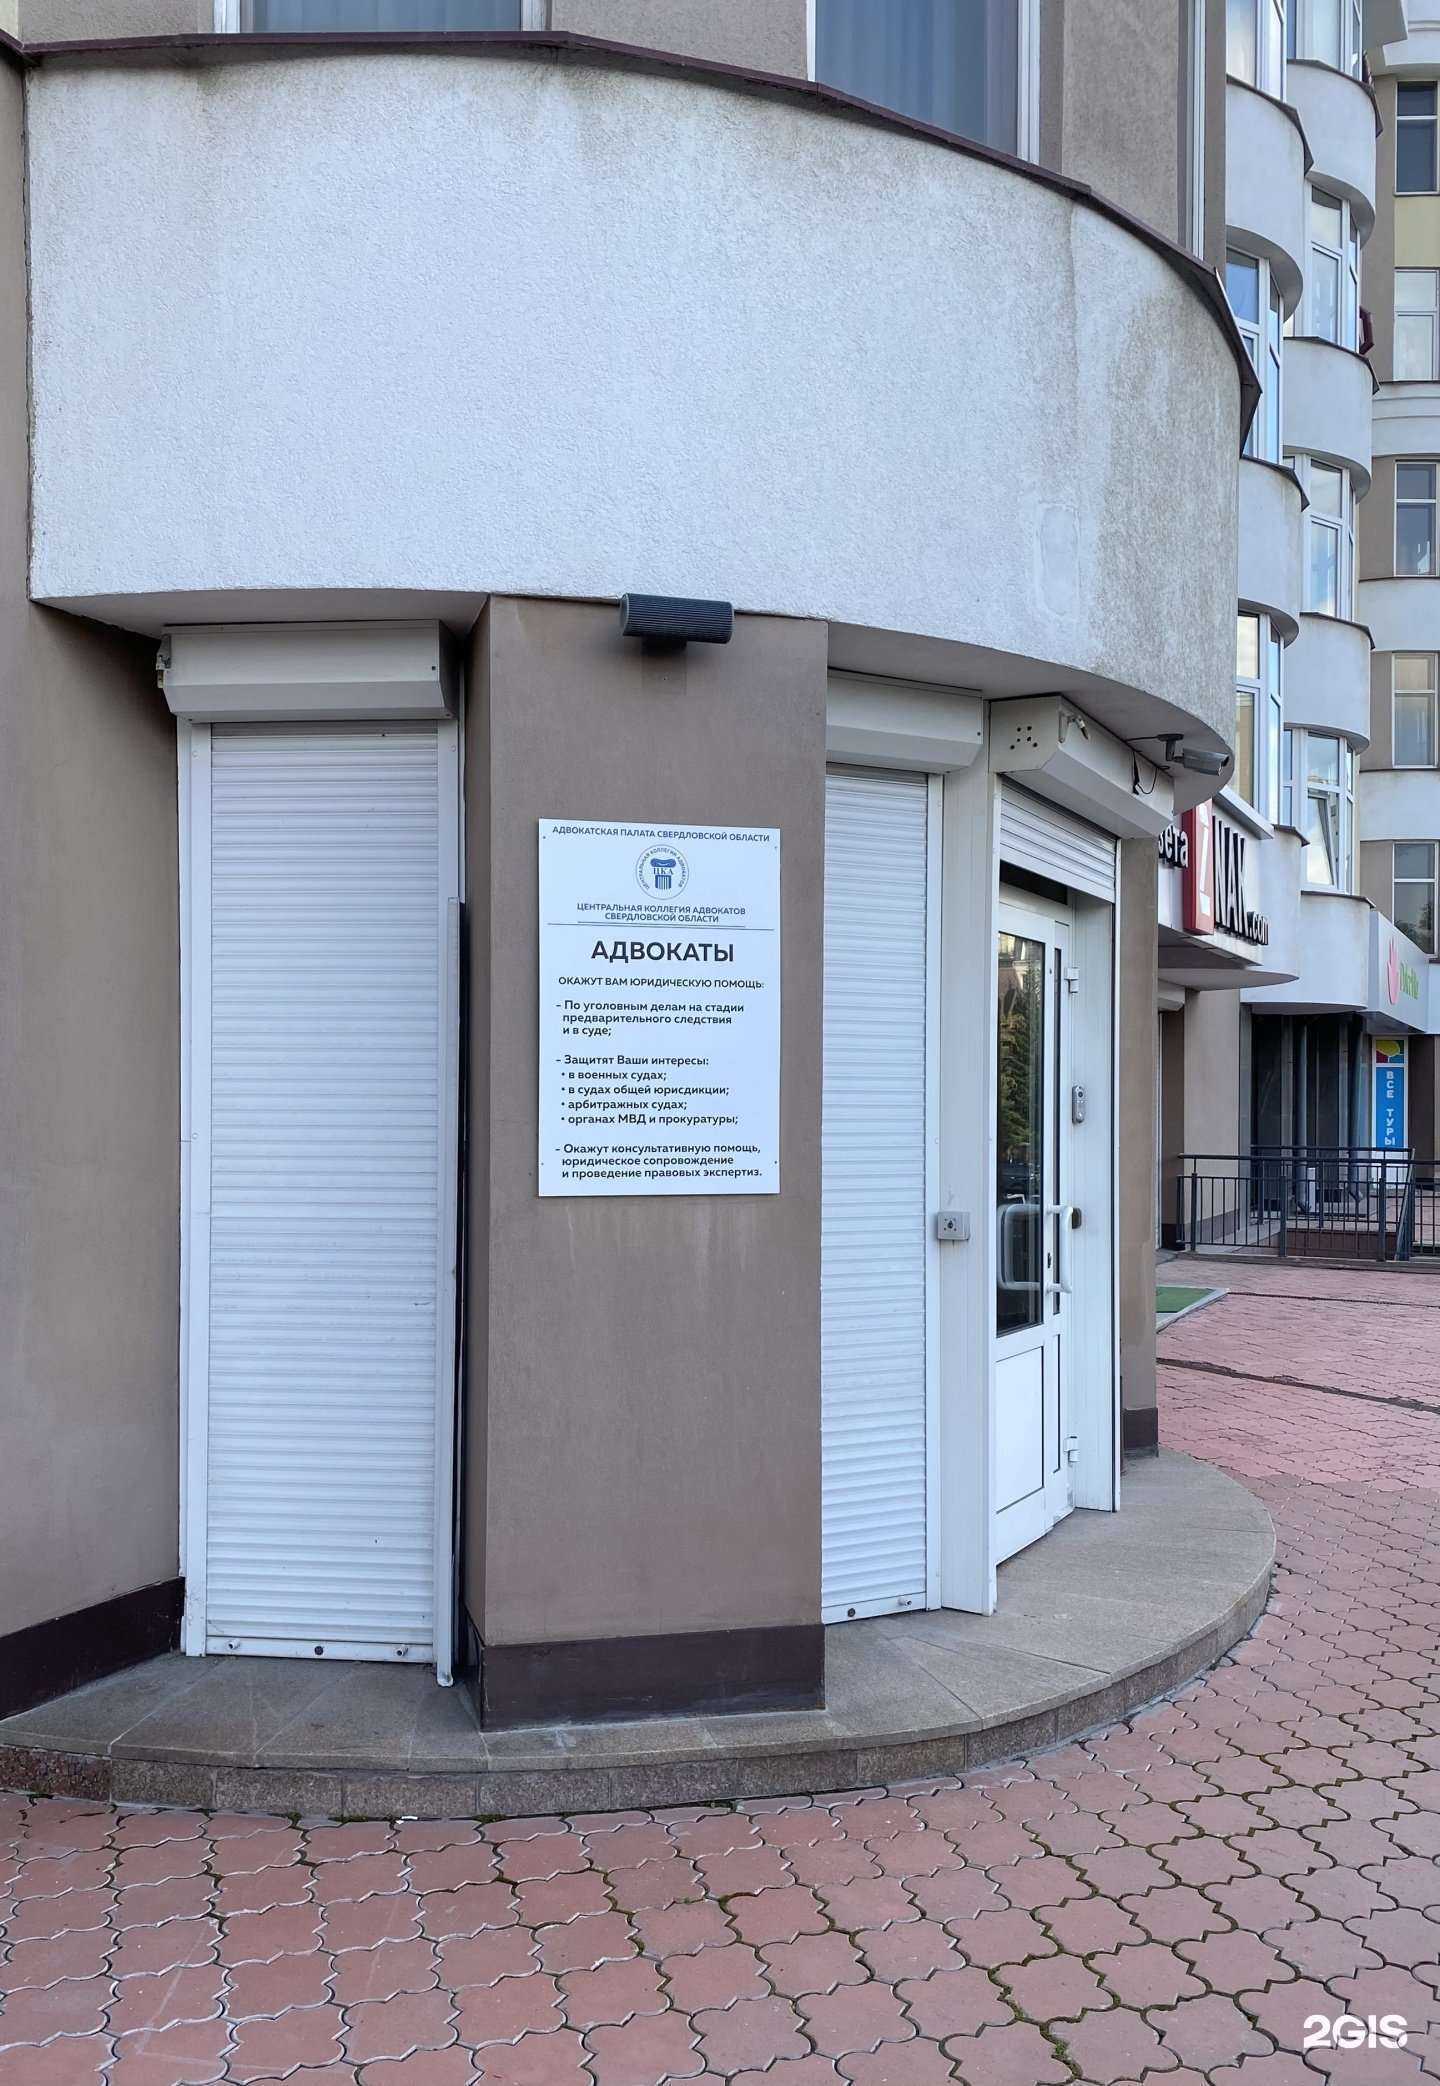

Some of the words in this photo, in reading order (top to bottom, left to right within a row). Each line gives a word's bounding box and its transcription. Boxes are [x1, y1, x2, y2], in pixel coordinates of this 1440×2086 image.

[552, 826, 618, 836] АДВОКАТСКАЯ
[620, 829, 655, 837] ПАЛАТА
[657, 830, 727, 840] СВЕРДЛОВСКОЙ
[730, 833, 770, 841] ОБЛАСТИ
[653, 867, 674, 876] ЦКА
[645, 905, 690, 913] КОЛЛЕГИЯ
[693, 907, 745, 915] АДВОКАТОВ
[605, 912, 675, 922] СВЕРДЛОВСКОЙ
[678, 915, 719, 923] ОБЛАСТИ
[591, 941, 734, 963] АДВОКАТЫ
[558, 977, 603, 985] ОКАЖУТ
[606, 978, 627, 986] ВАМ
[630, 978, 711, 987] ЮРИДИЧЕСКУЮ
[714, 980, 765, 989] ПОМОЩЬ:
[564, 1001, 580, 1010] По
[583, 1003, 648, 1013] уголовным
[651, 1003, 686, 1013] делам
[688, 1004, 702, 1012] на
[705, 1005, 744, 1013] стадии
[563, 1015, 671, 1025] предварительного
[674, 1016, 732, 1025] следствия
[582, 1027, 612, 1036] суде;
[564, 1055, 614, 1066] Защитят
[617, 1056, 648, 1064] Ваши
[651, 1057, 709, 1067] интересы:
[631, 1072, 667, 1081] судах;
[1386, 1071, 1394, 1098] ВСЕ
[578, 1086, 610, 1096] судах
[614, 1085, 651, 1096] общей
[654, 1086, 729, 1096] юрисдикции;
[568, 1100, 648, 1110] арбитражных
[651, 1101, 687, 1110] судах;
[568, 1116, 615, 1124] органах
[618, 1115, 646, 1124] МВД
[659, 1116, 738, 1125] прокуратуры;
[1384, 1108, 1396, 1146] ТУРЫ
[564, 1144, 608, 1154] Окажут
[612, 1145, 710, 1154] консультативную
[714, 1145, 761, 1154] помощь,
[562, 1157, 641, 1166] юридическое
[643, 1157, 733, 1166] сопровождение
[572, 1170, 641, 1179] проведение
[645, 1170, 700, 1178] правовых
[703, 1169, 762, 1177] экспертиз.
